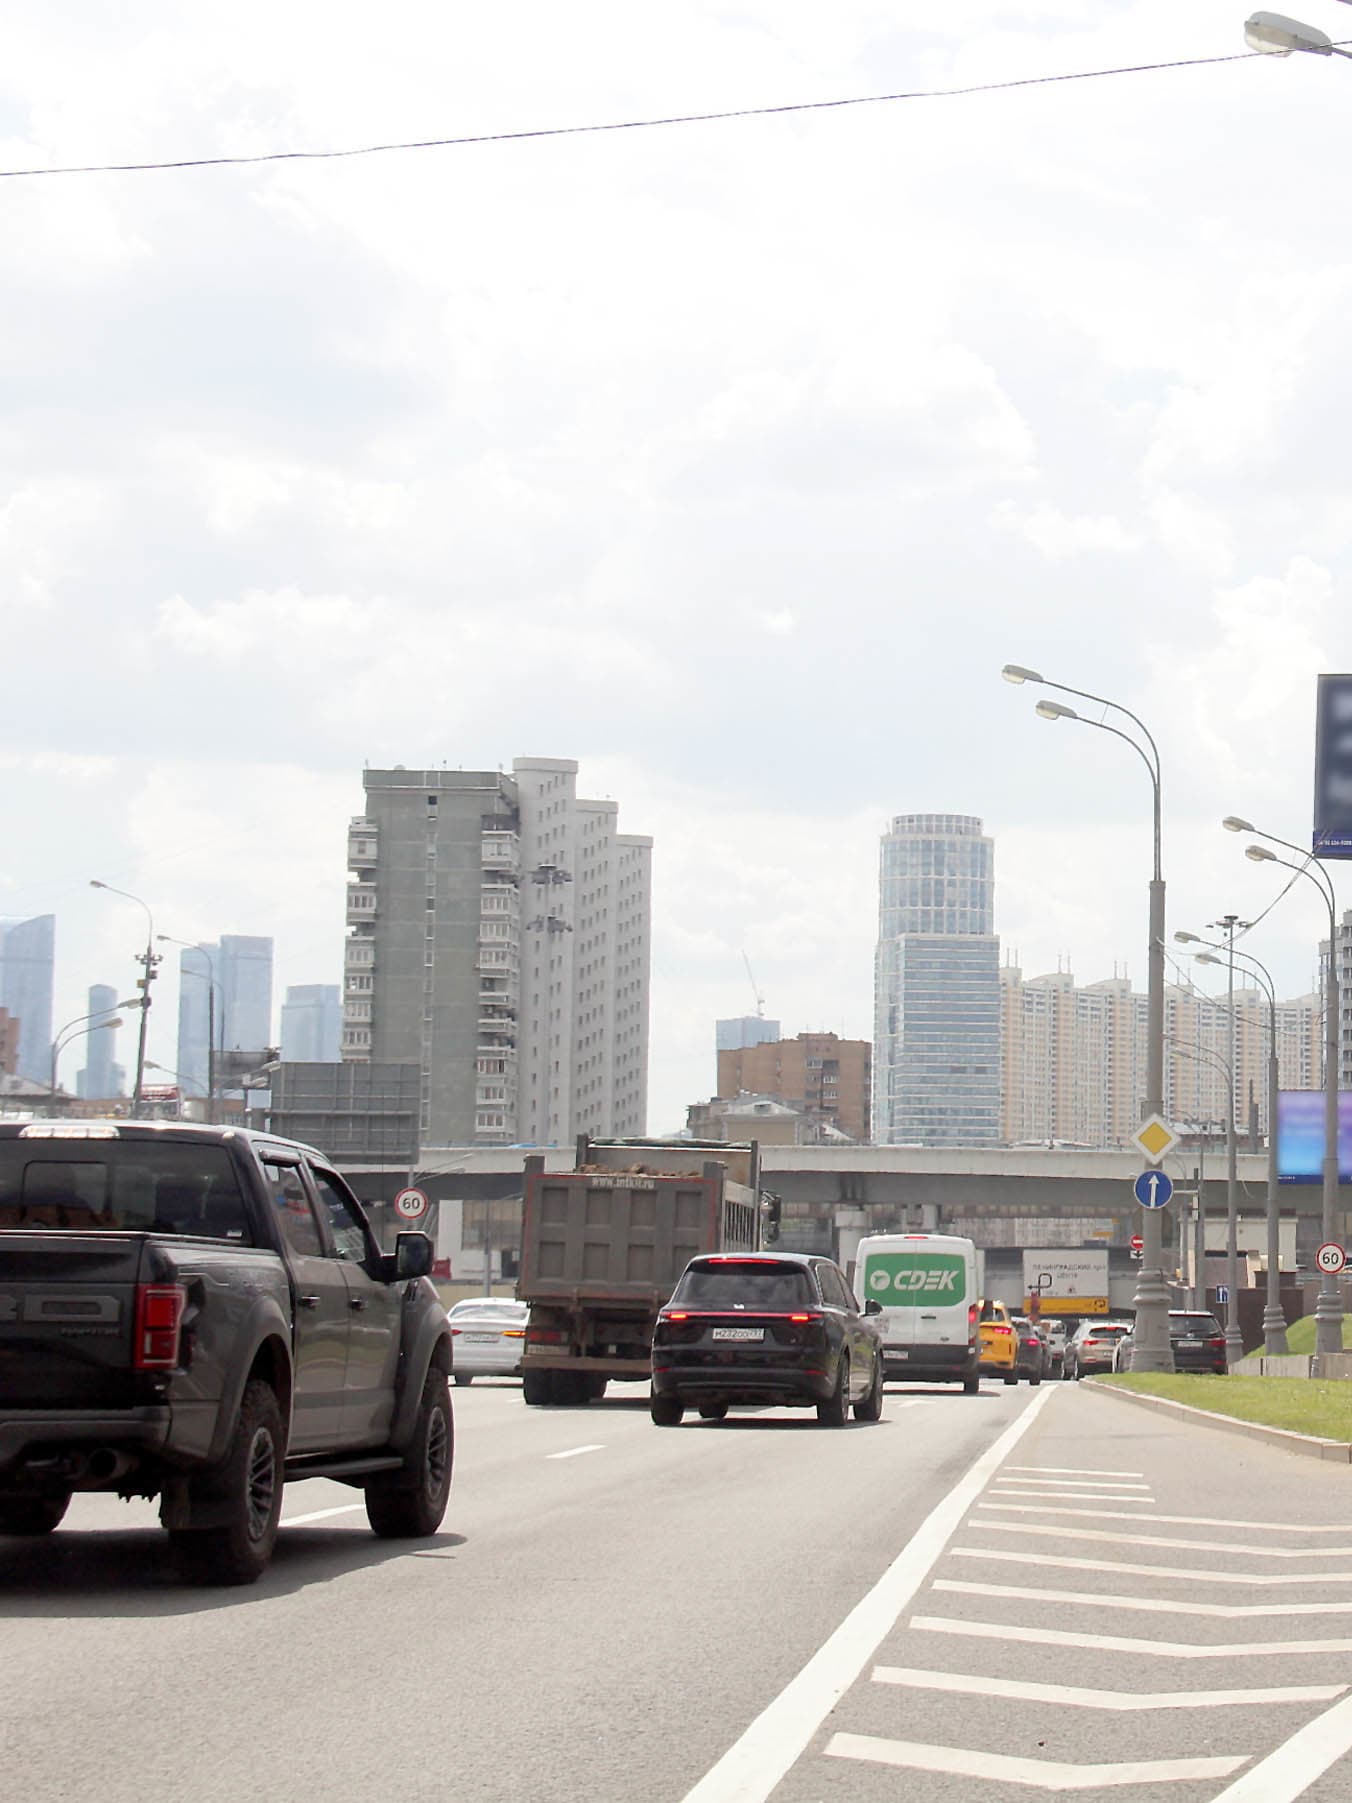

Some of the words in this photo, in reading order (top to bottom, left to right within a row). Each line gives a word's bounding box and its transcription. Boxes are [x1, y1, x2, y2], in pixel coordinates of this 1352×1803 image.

[403, 1197, 421, 1211] 60
[1322, 1252, 1339, 1265] 60
[894, 1270, 960, 1291] CDEK
